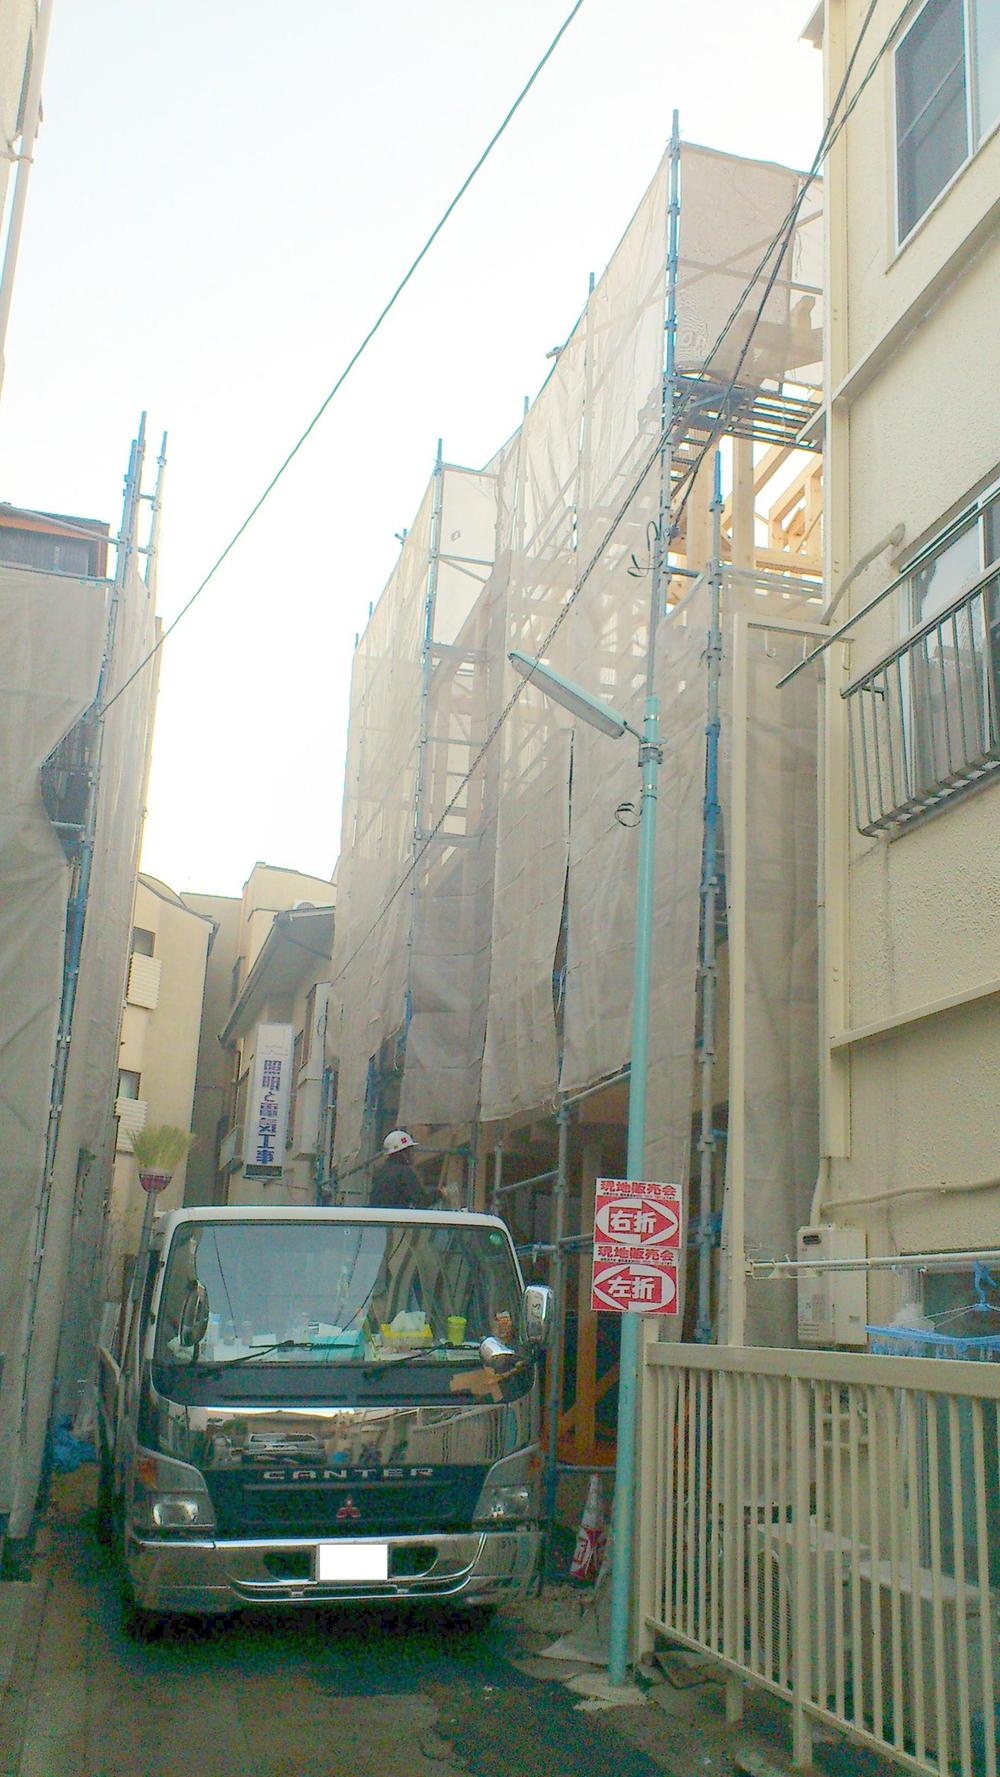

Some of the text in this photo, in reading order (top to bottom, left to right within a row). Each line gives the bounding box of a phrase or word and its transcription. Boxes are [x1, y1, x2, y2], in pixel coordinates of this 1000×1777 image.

[600, 1180, 677, 1196] 現地販売会
[610, 1209, 657, 1233] 右折
[597, 1246, 674, 1262] 現地販売会
[607, 1276, 655, 1299] 左折
[263, 1468, 433, 1480] CANTER
